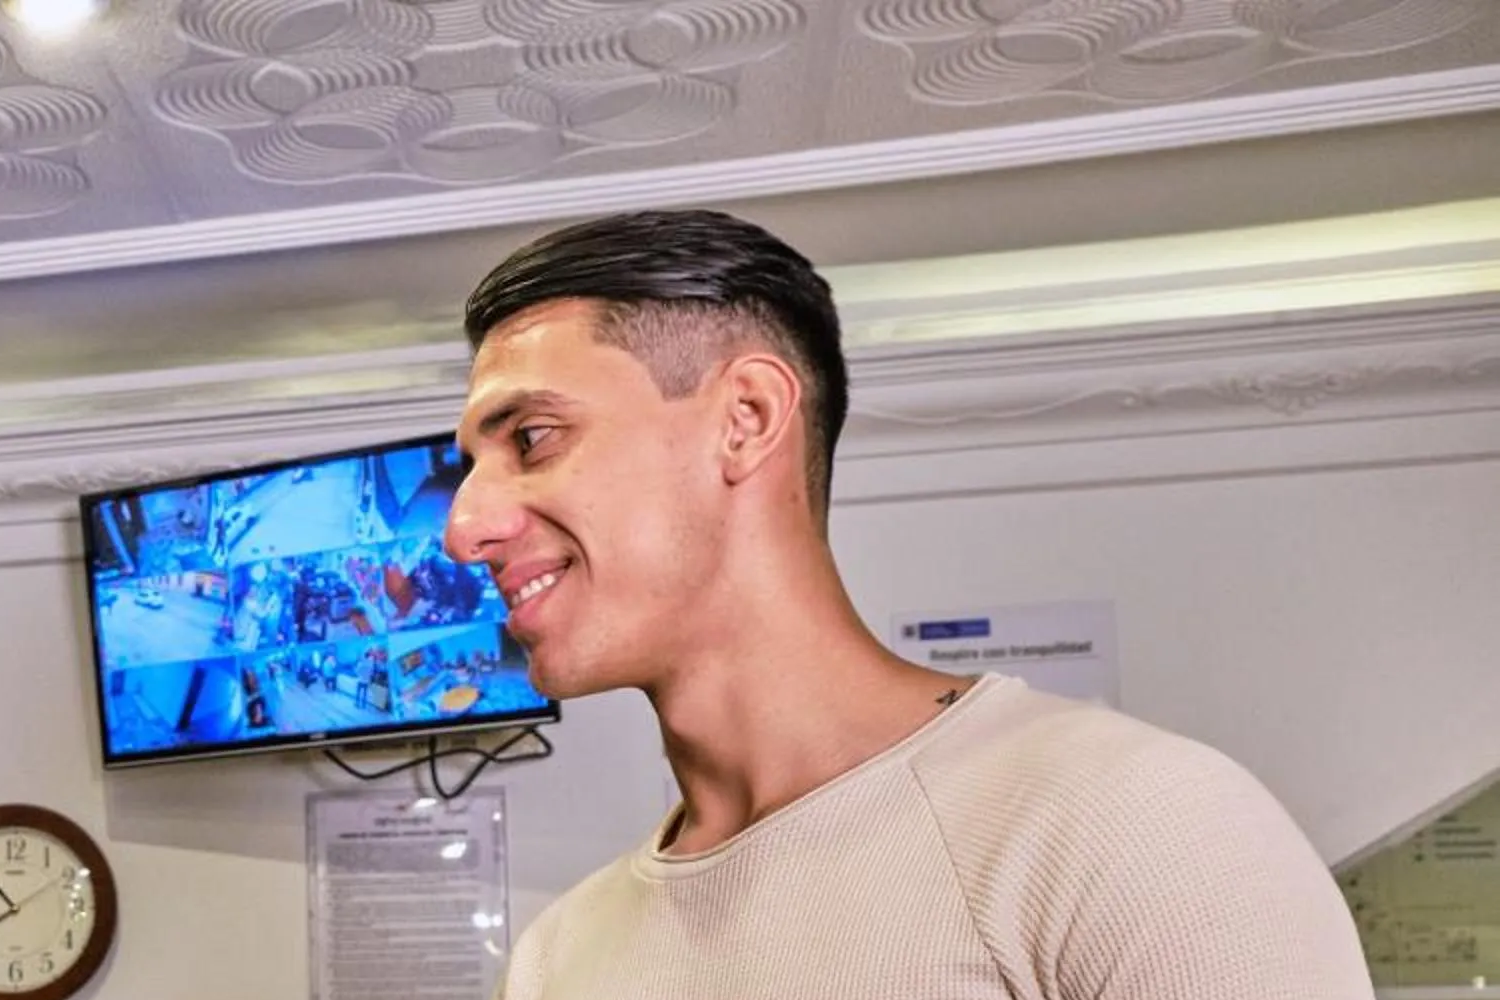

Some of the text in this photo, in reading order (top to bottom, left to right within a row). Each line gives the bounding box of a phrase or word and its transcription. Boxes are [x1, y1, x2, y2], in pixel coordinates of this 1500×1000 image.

[6, 838, 26, 861] 12
[44, 846, 50, 868] 1
[62, 866, 77, 890] 2
[8, 960, 24, 983] 6
[39, 952, 54, 973] 5
